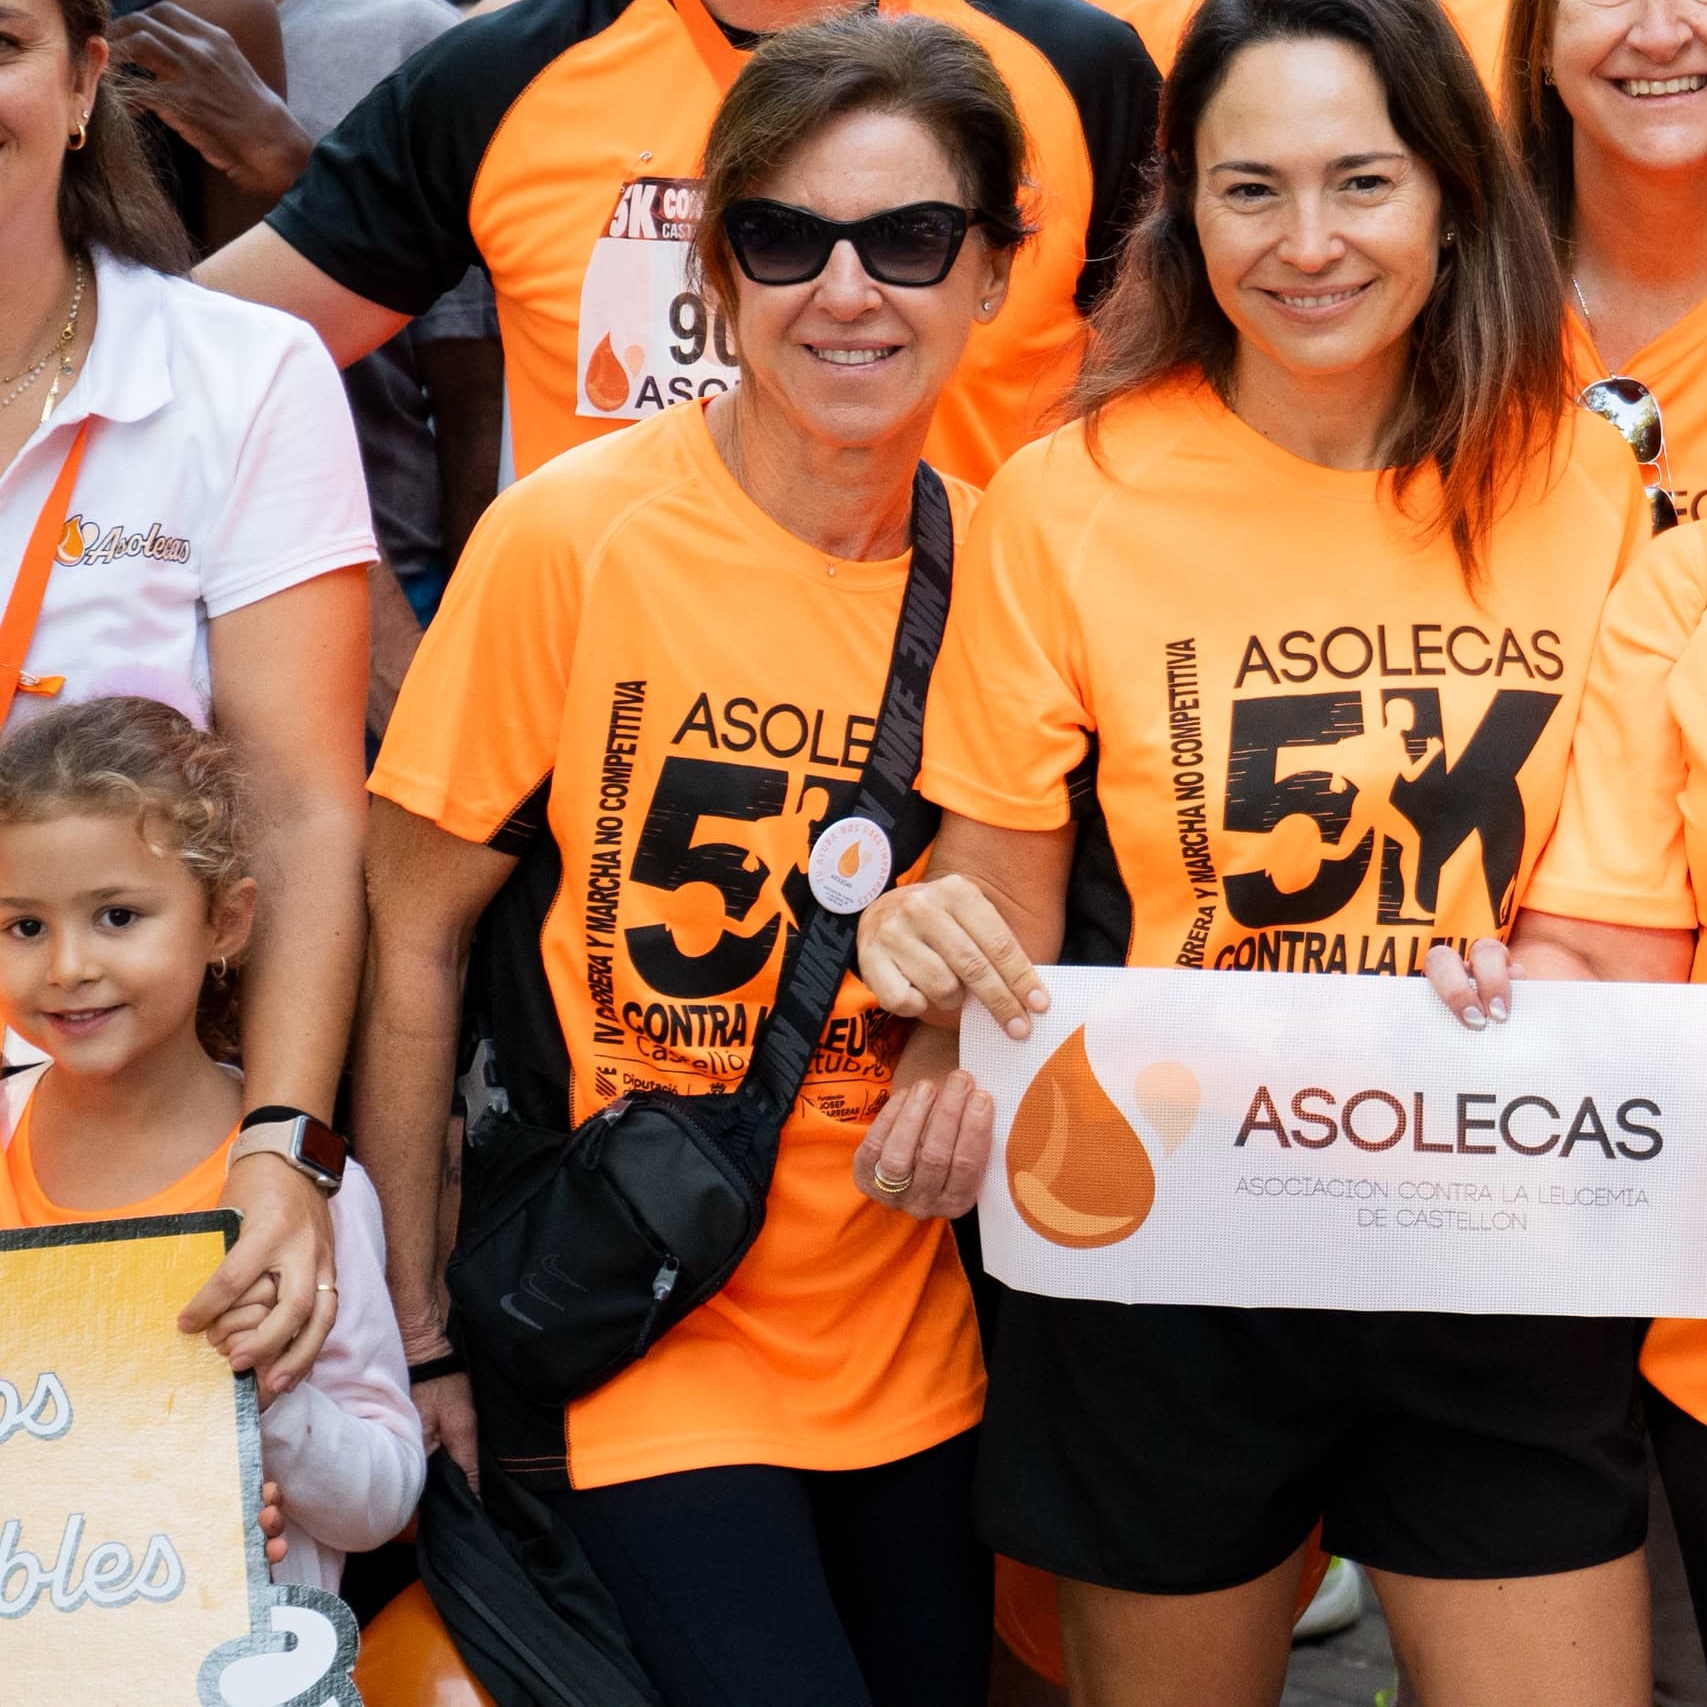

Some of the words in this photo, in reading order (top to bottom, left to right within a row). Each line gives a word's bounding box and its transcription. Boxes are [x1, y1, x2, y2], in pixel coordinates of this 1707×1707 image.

[1232, 624, 1565, 689] ASOLECAS
[1165, 637, 1205, 768] COMPETITIVA
[599, 680, 648, 812] COMPETITIVA
[1176, 771, 1205, 802] NO
[1221, 687, 1564, 929] 5K
[592, 816, 624, 846] NO
[1176, 803, 1218, 892] MARCHA
[586, 850, 621, 937] MARCHA
[623, 755, 863, 1000] 5
[1196, 886, 1219, 901] Y
[587, 934, 614, 950] Y
[1213, 929, 1348, 975] CONTRA
[1358, 935, 1398, 977] LA
[593, 1020, 625, 1046] IV
[622, 1000, 747, 1049] CONTRA
[636, 1035, 750, 1082] Castelló
[1232, 1085, 1664, 1161] ASOLECAS
[1357, 1207, 1388, 1228] DE
[1399, 1180, 1493, 1204] CONTRA
[1502, 1183, 1530, 1205] LA
[1538, 1185, 1650, 1208] LEUCEMIA
